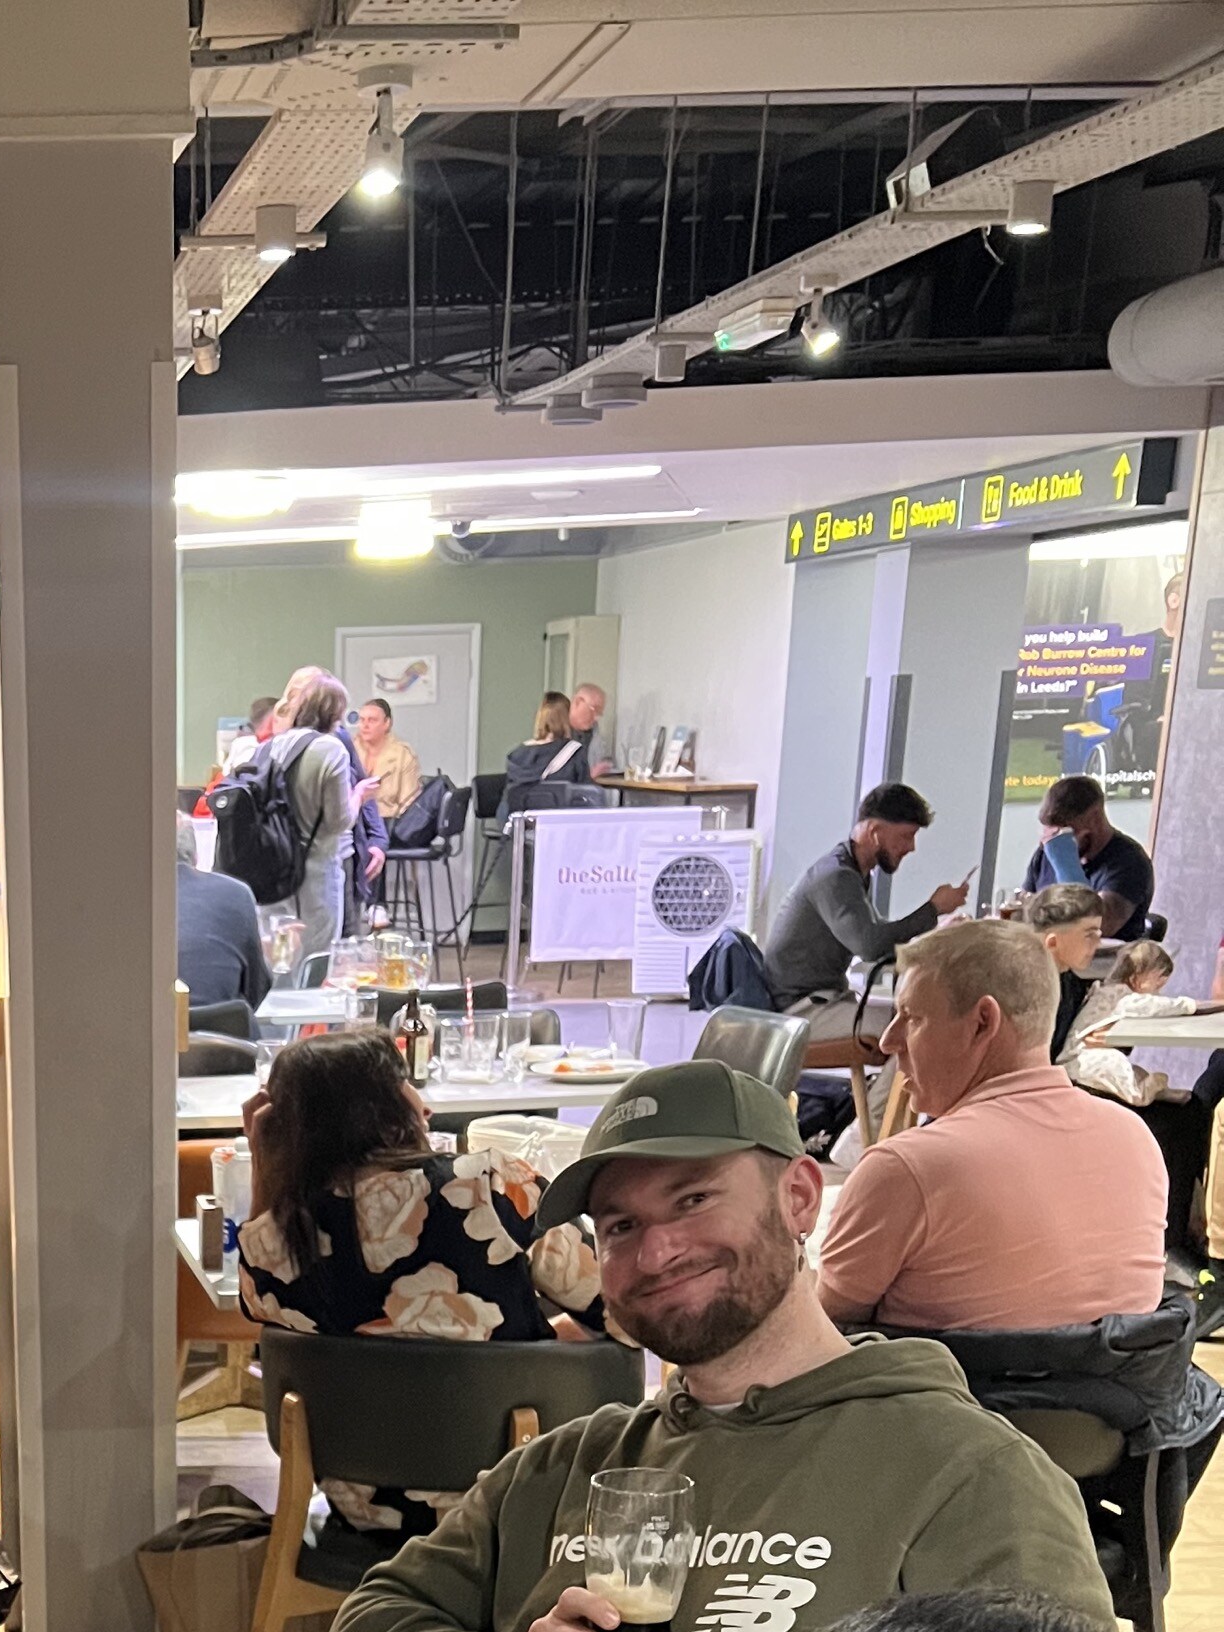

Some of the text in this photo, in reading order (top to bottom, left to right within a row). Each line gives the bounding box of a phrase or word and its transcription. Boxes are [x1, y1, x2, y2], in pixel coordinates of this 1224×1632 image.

[1007, 468, 1083, 508] Food & Drink
[910, 496, 956, 527] Shopping
[858, 511, 874, 536] 1-3
[1024, 628, 1109, 647] you help build
[1042, 647, 1086, 660] Burrow
[1087, 646, 1127, 659] Centre
[1129, 644, 1147, 657] for
[1027, 663, 1078, 677] Neurone
[1079, 662, 1126, 675] Disease
